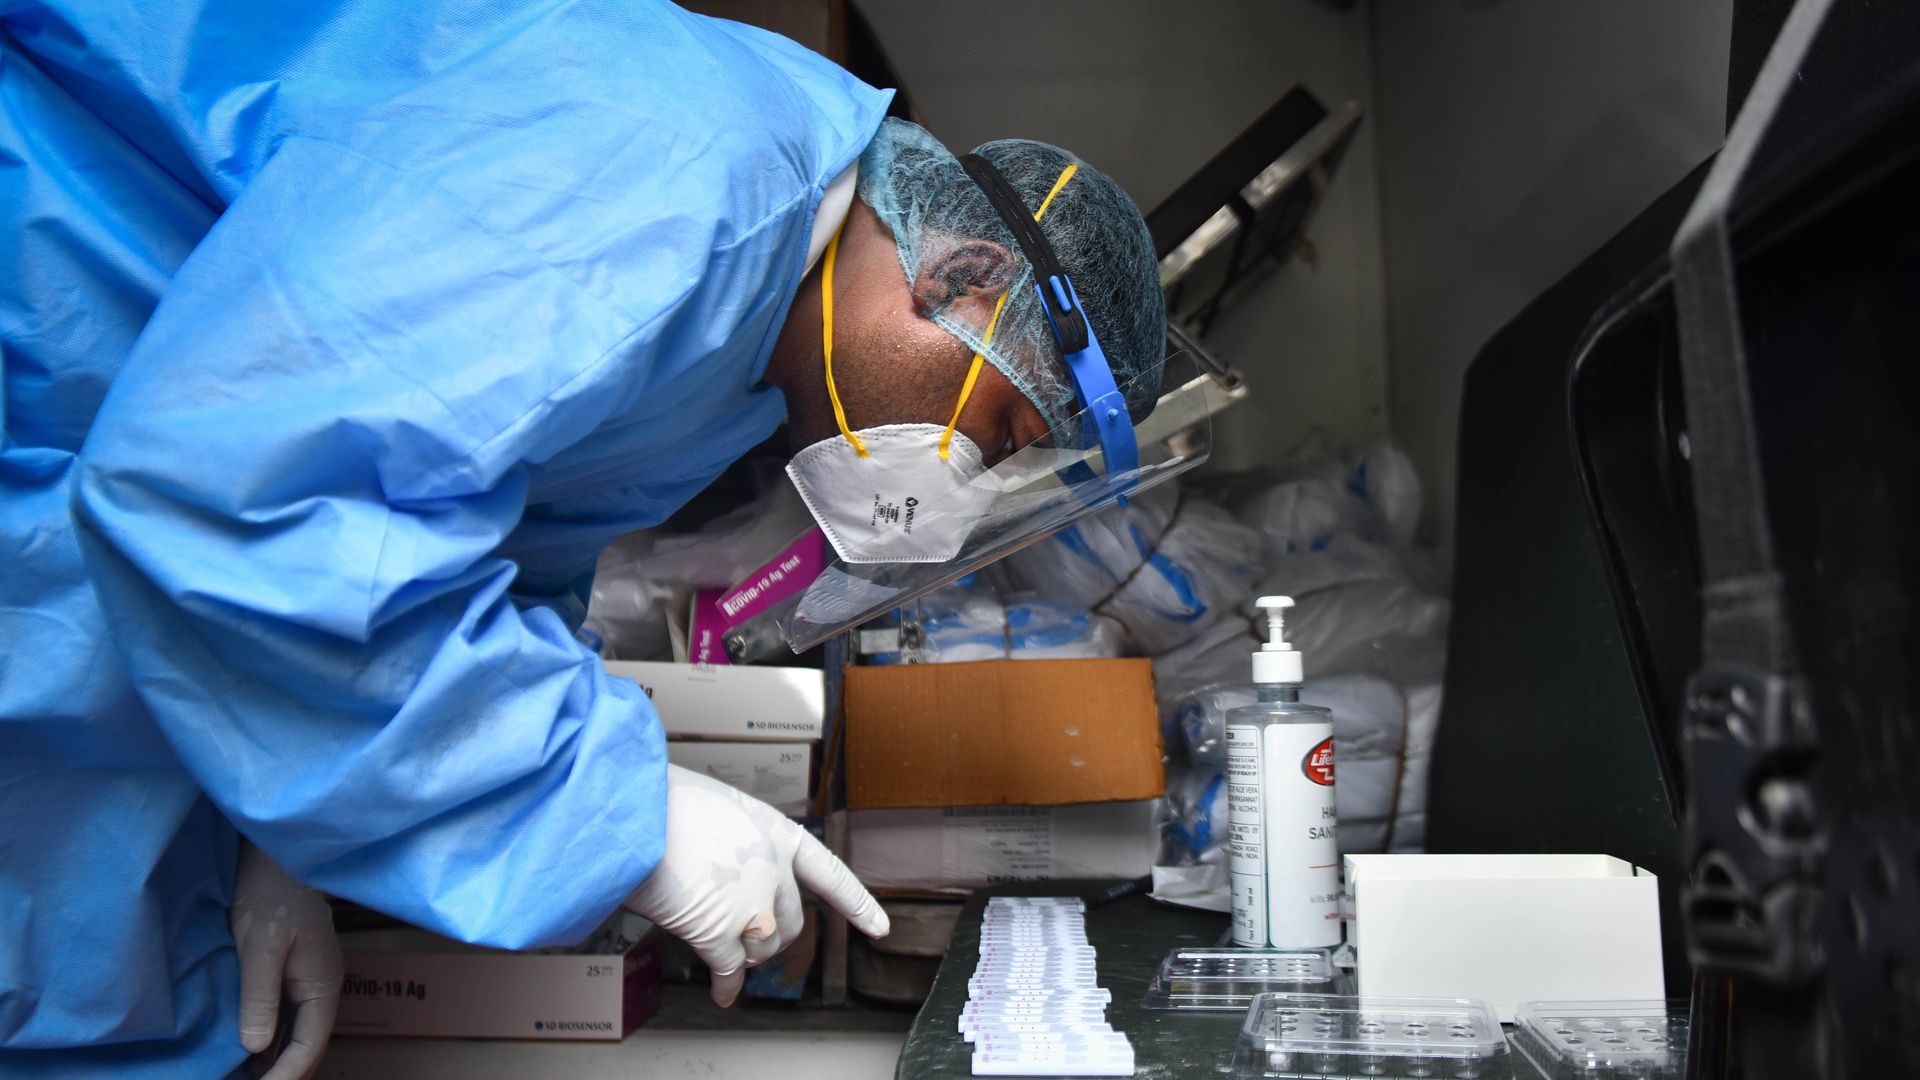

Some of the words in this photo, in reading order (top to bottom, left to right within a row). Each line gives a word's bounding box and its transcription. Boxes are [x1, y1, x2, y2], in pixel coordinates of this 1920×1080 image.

[730, 578, 770, 613] COVID-19
[769, 569, 783, 583] Ag
[780, 555, 800, 573] Test
[767, 723, 815, 731] BIOSENSOR
[586, 965, 600, 977] 25
[342, 979, 402, 997] OVID-19
[406, 980, 426, 1000] Ag
[558, 1021, 614, 1031] BIOSENSOR
